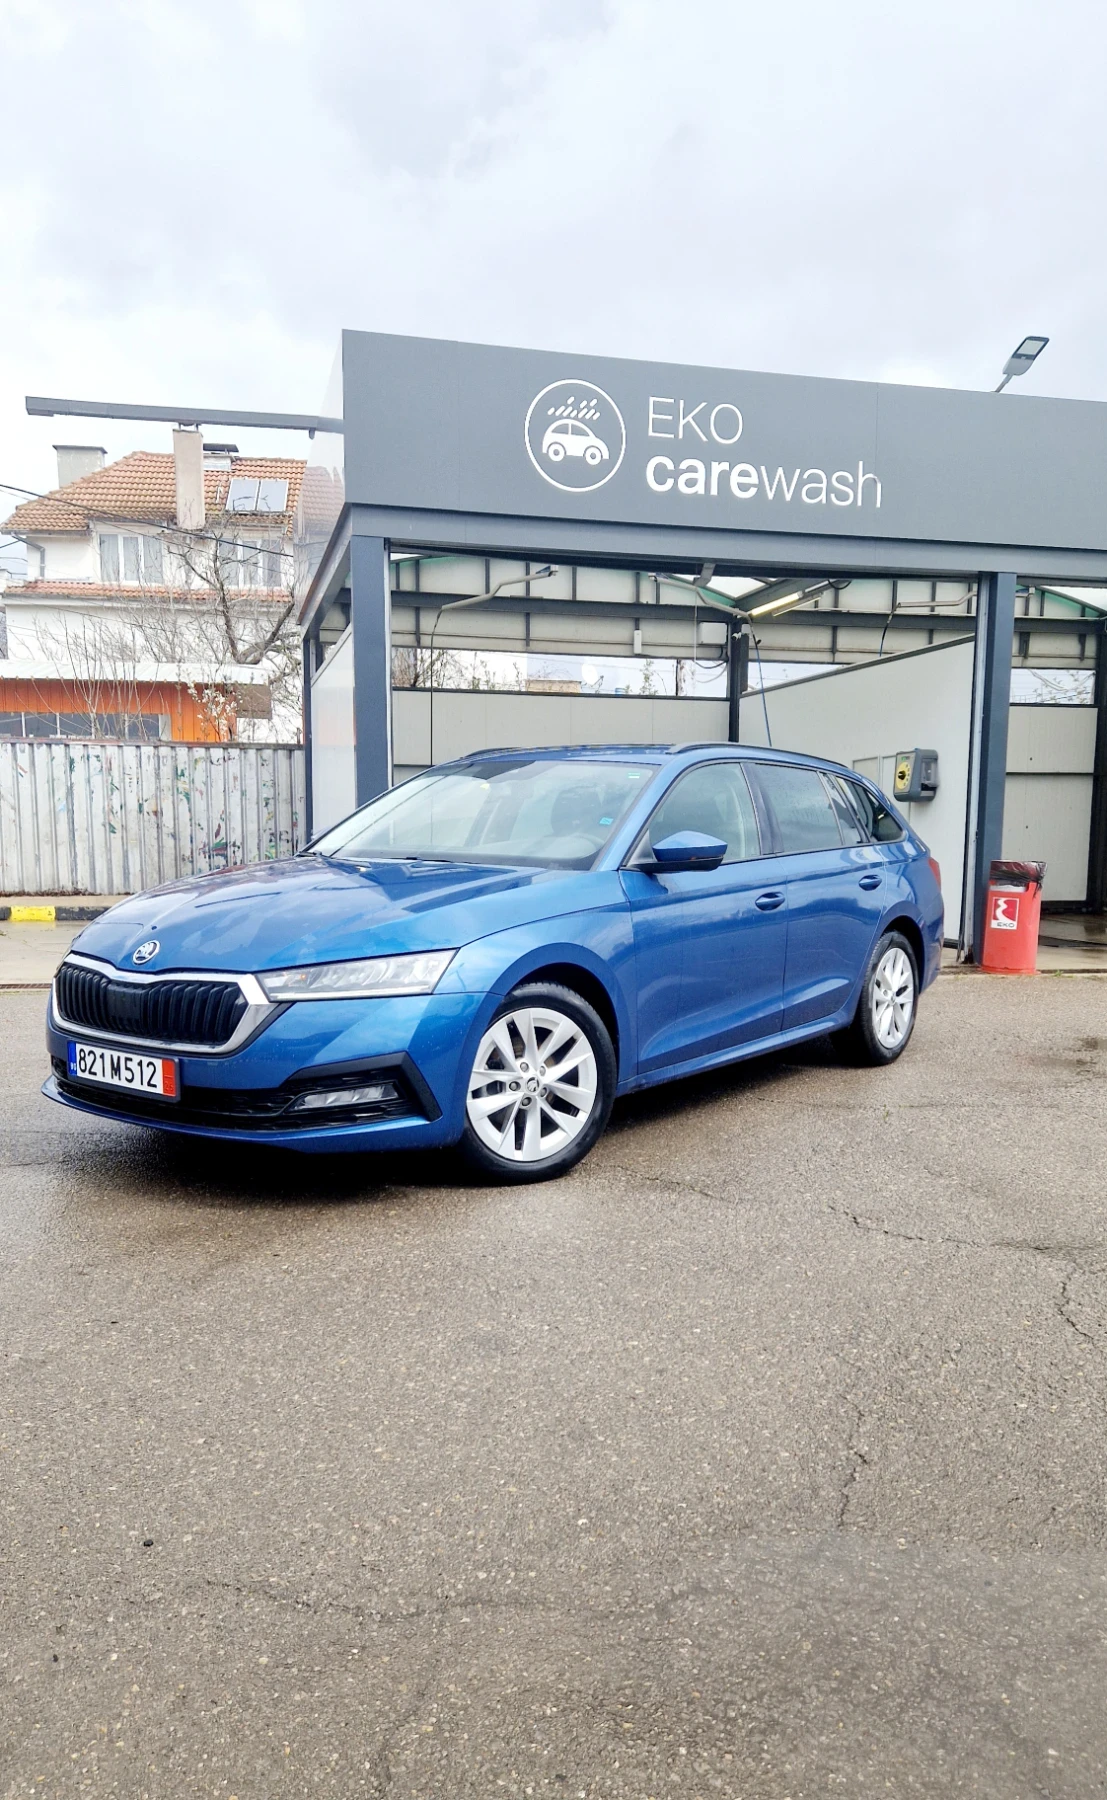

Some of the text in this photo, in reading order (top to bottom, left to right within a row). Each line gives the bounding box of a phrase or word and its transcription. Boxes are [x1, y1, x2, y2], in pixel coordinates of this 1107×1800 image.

[648, 396, 744, 444] EKO
[646, 455, 882, 508] carewash
[78, 1048, 158, 1089] 821M512
